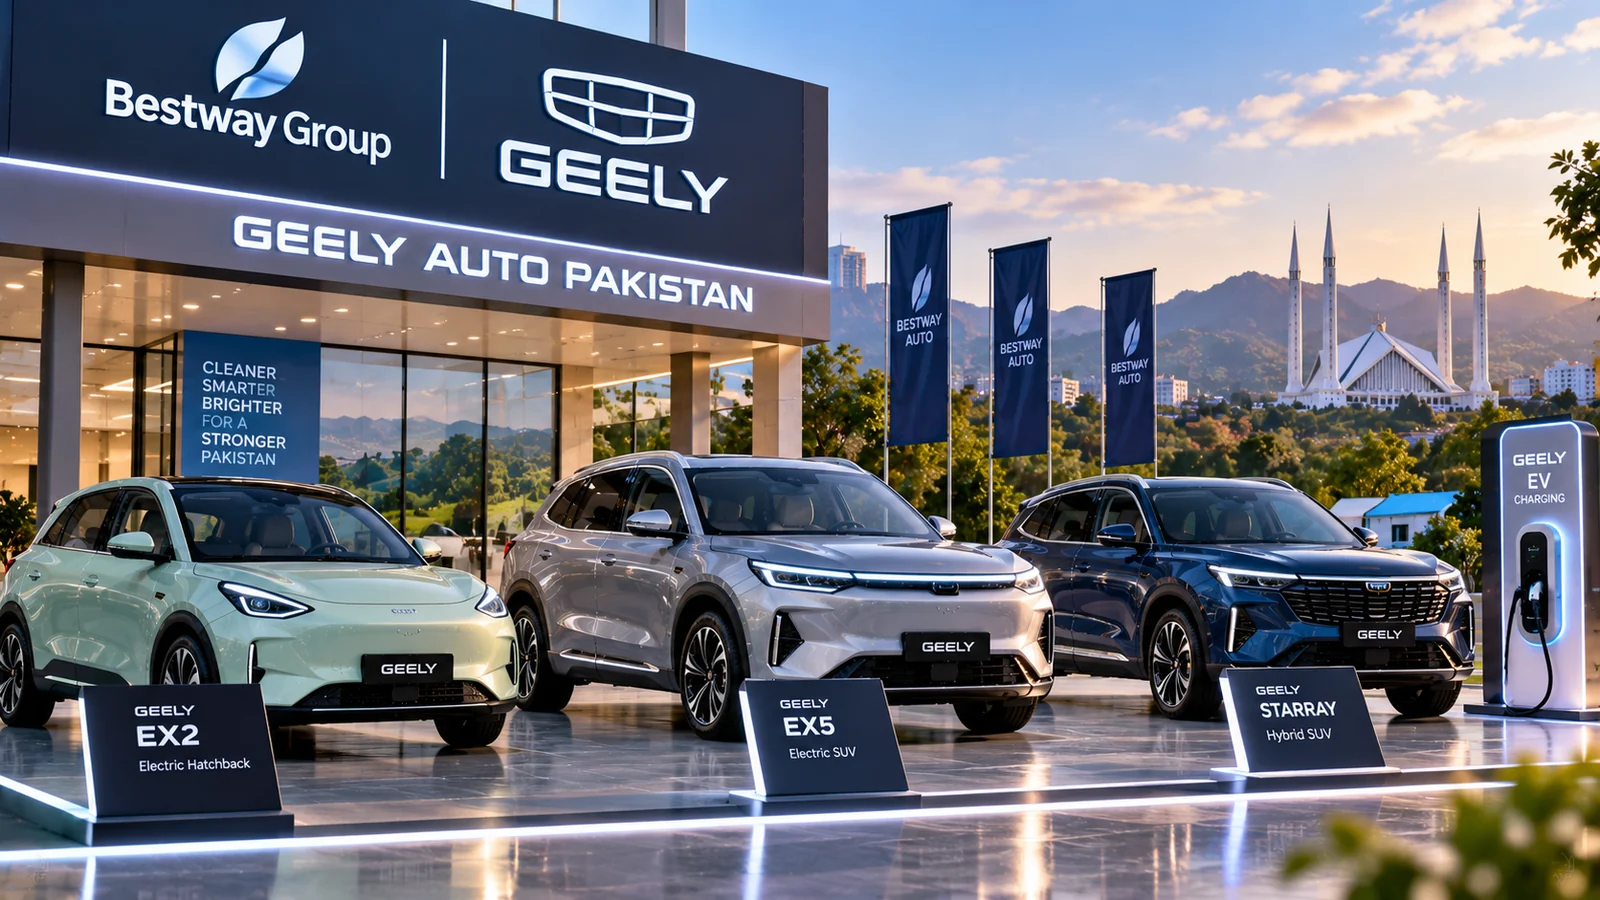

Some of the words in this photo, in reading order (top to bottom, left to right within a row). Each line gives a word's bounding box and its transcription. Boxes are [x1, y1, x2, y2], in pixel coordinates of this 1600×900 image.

[105, 78, 278, 148] Bestway
[283, 110, 392, 166] Group
[500, 139, 729, 214] GEELY
[233, 215, 407, 267] GEELY
[423, 242, 549, 286] AUTO
[565, 260, 754, 313] PAKISTAN
[896, 313, 943, 332] BESTWAY
[905, 330, 934, 347] AUTO
[1000, 337, 1043, 355] BESTWAY
[1008, 353, 1034, 368] AUTO
[1111, 358, 1149, 373] BESTWAY
[202, 361, 277, 380] CLEANER
[1118, 372, 1142, 386] AUTO
[202, 378, 276, 397] SMARTER
[202, 396, 283, 415] BRIGHTER
[202, 414, 233, 429] FOR
[237, 416, 248, 430] A
[201, 432, 287, 450] STRONGER
[201, 450, 276, 466] PAKISTAN
[1512, 451, 1567, 467] GEELY
[1527, 472, 1551, 490] EV
[1514, 493, 1566, 505] CHARGING
[1357, 630, 1403, 640] GEELY
[922, 641, 975, 652] GEELY
[381, 663, 437, 675] GEELY
[1255, 685, 1300, 696] GEELY
[134, 705, 195, 717] GEELY
[779, 699, 829, 709] GEELY
[1260, 701, 1337, 718] STARRAY
[783, 716, 835, 736] EX5
[136, 724, 200, 747] EX2
[1266, 728, 1305, 743] Hybrid
[1307, 728, 1332, 739] SUV
[789, 747, 831, 759] Electric
[833, 746, 856, 758] SUV
[139, 759, 185, 772] Electric
[187, 757, 251, 770] Hatchback
